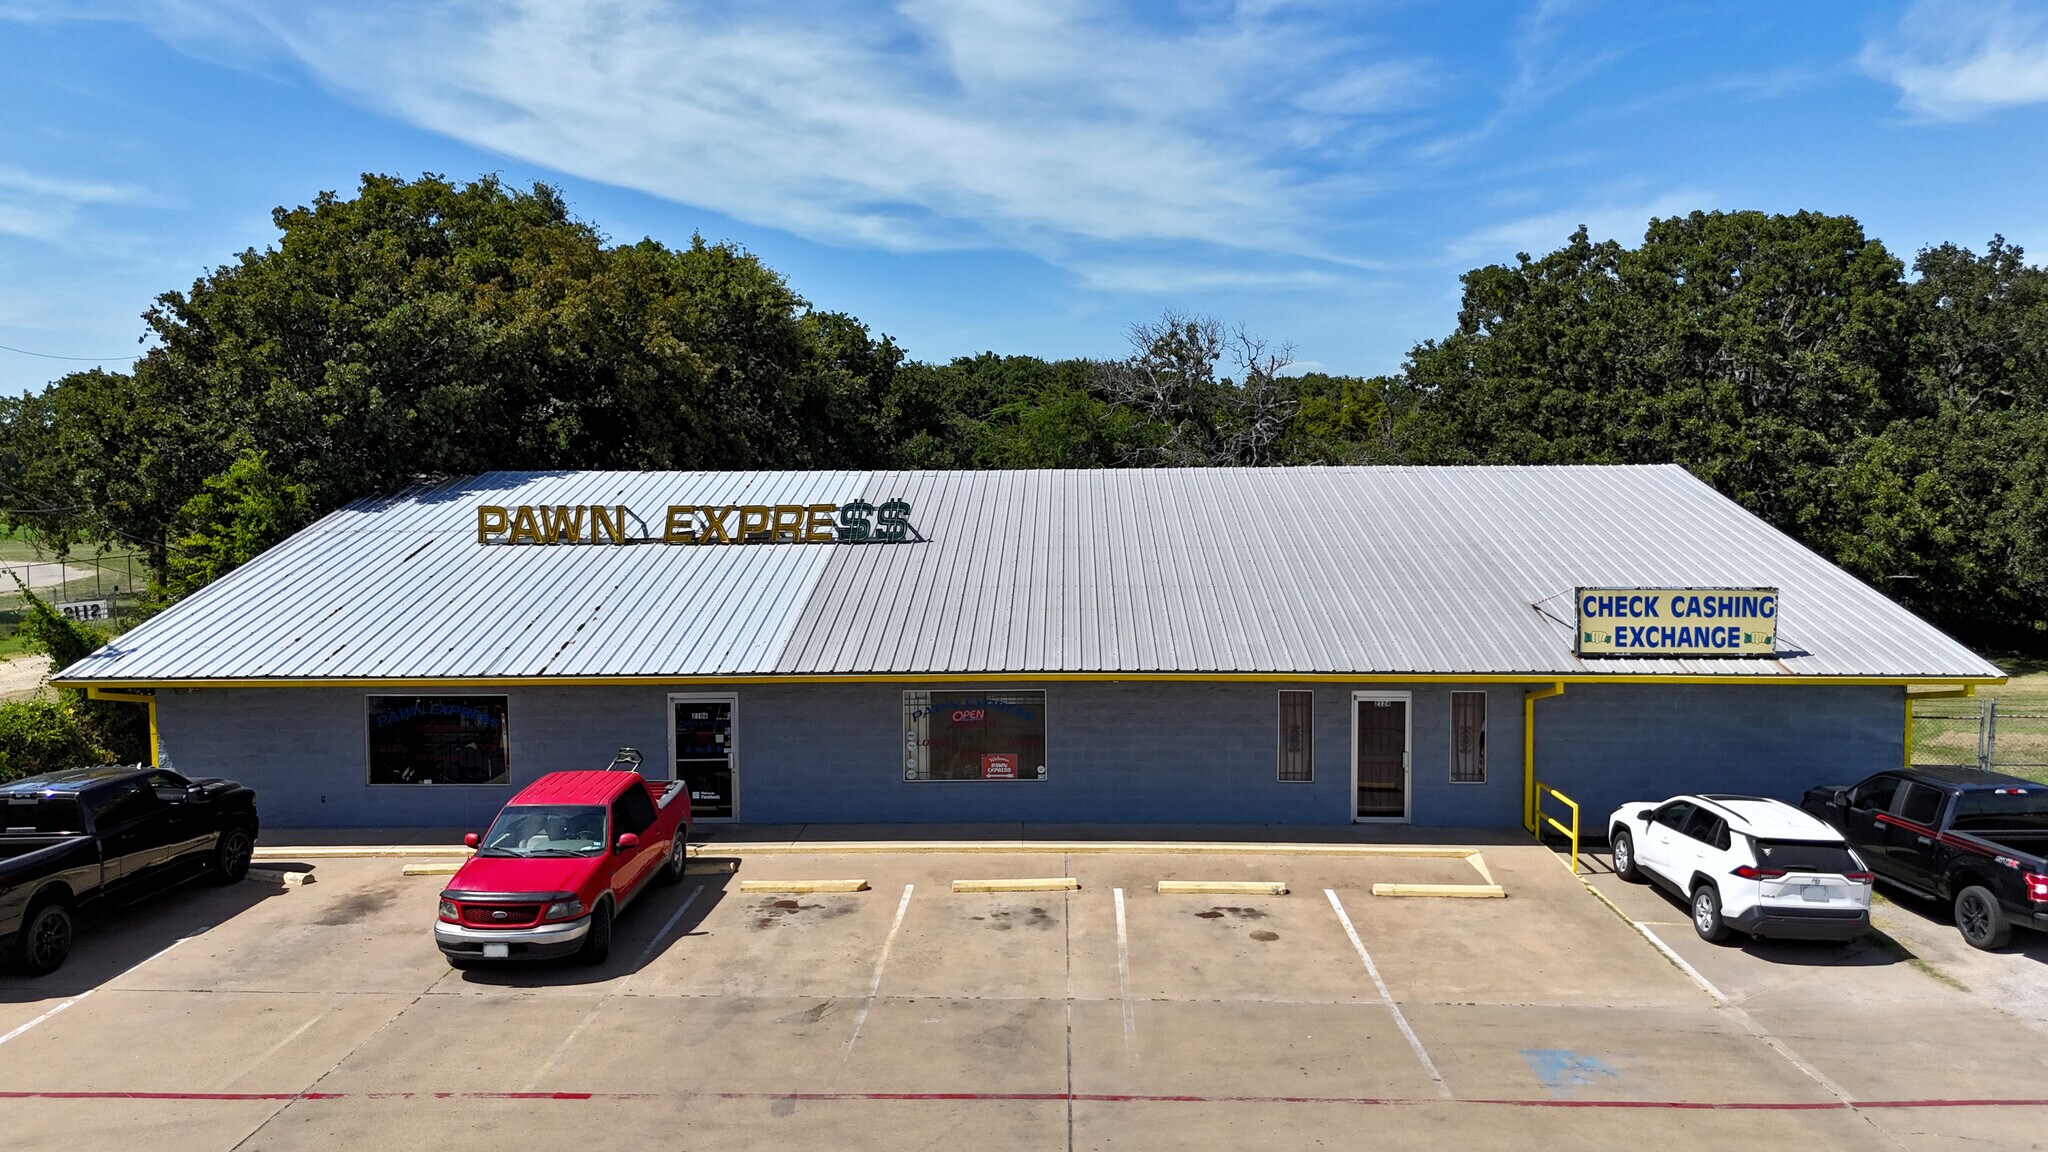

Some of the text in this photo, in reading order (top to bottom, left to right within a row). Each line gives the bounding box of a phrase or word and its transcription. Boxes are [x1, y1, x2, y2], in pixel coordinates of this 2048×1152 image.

[478, 504, 625, 544] PAWN
[1583, 595, 1775, 618] CHECK CASHING
[1614, 626, 1741, 648] EXCHANGE
[952, 709, 985, 722] OPEN
